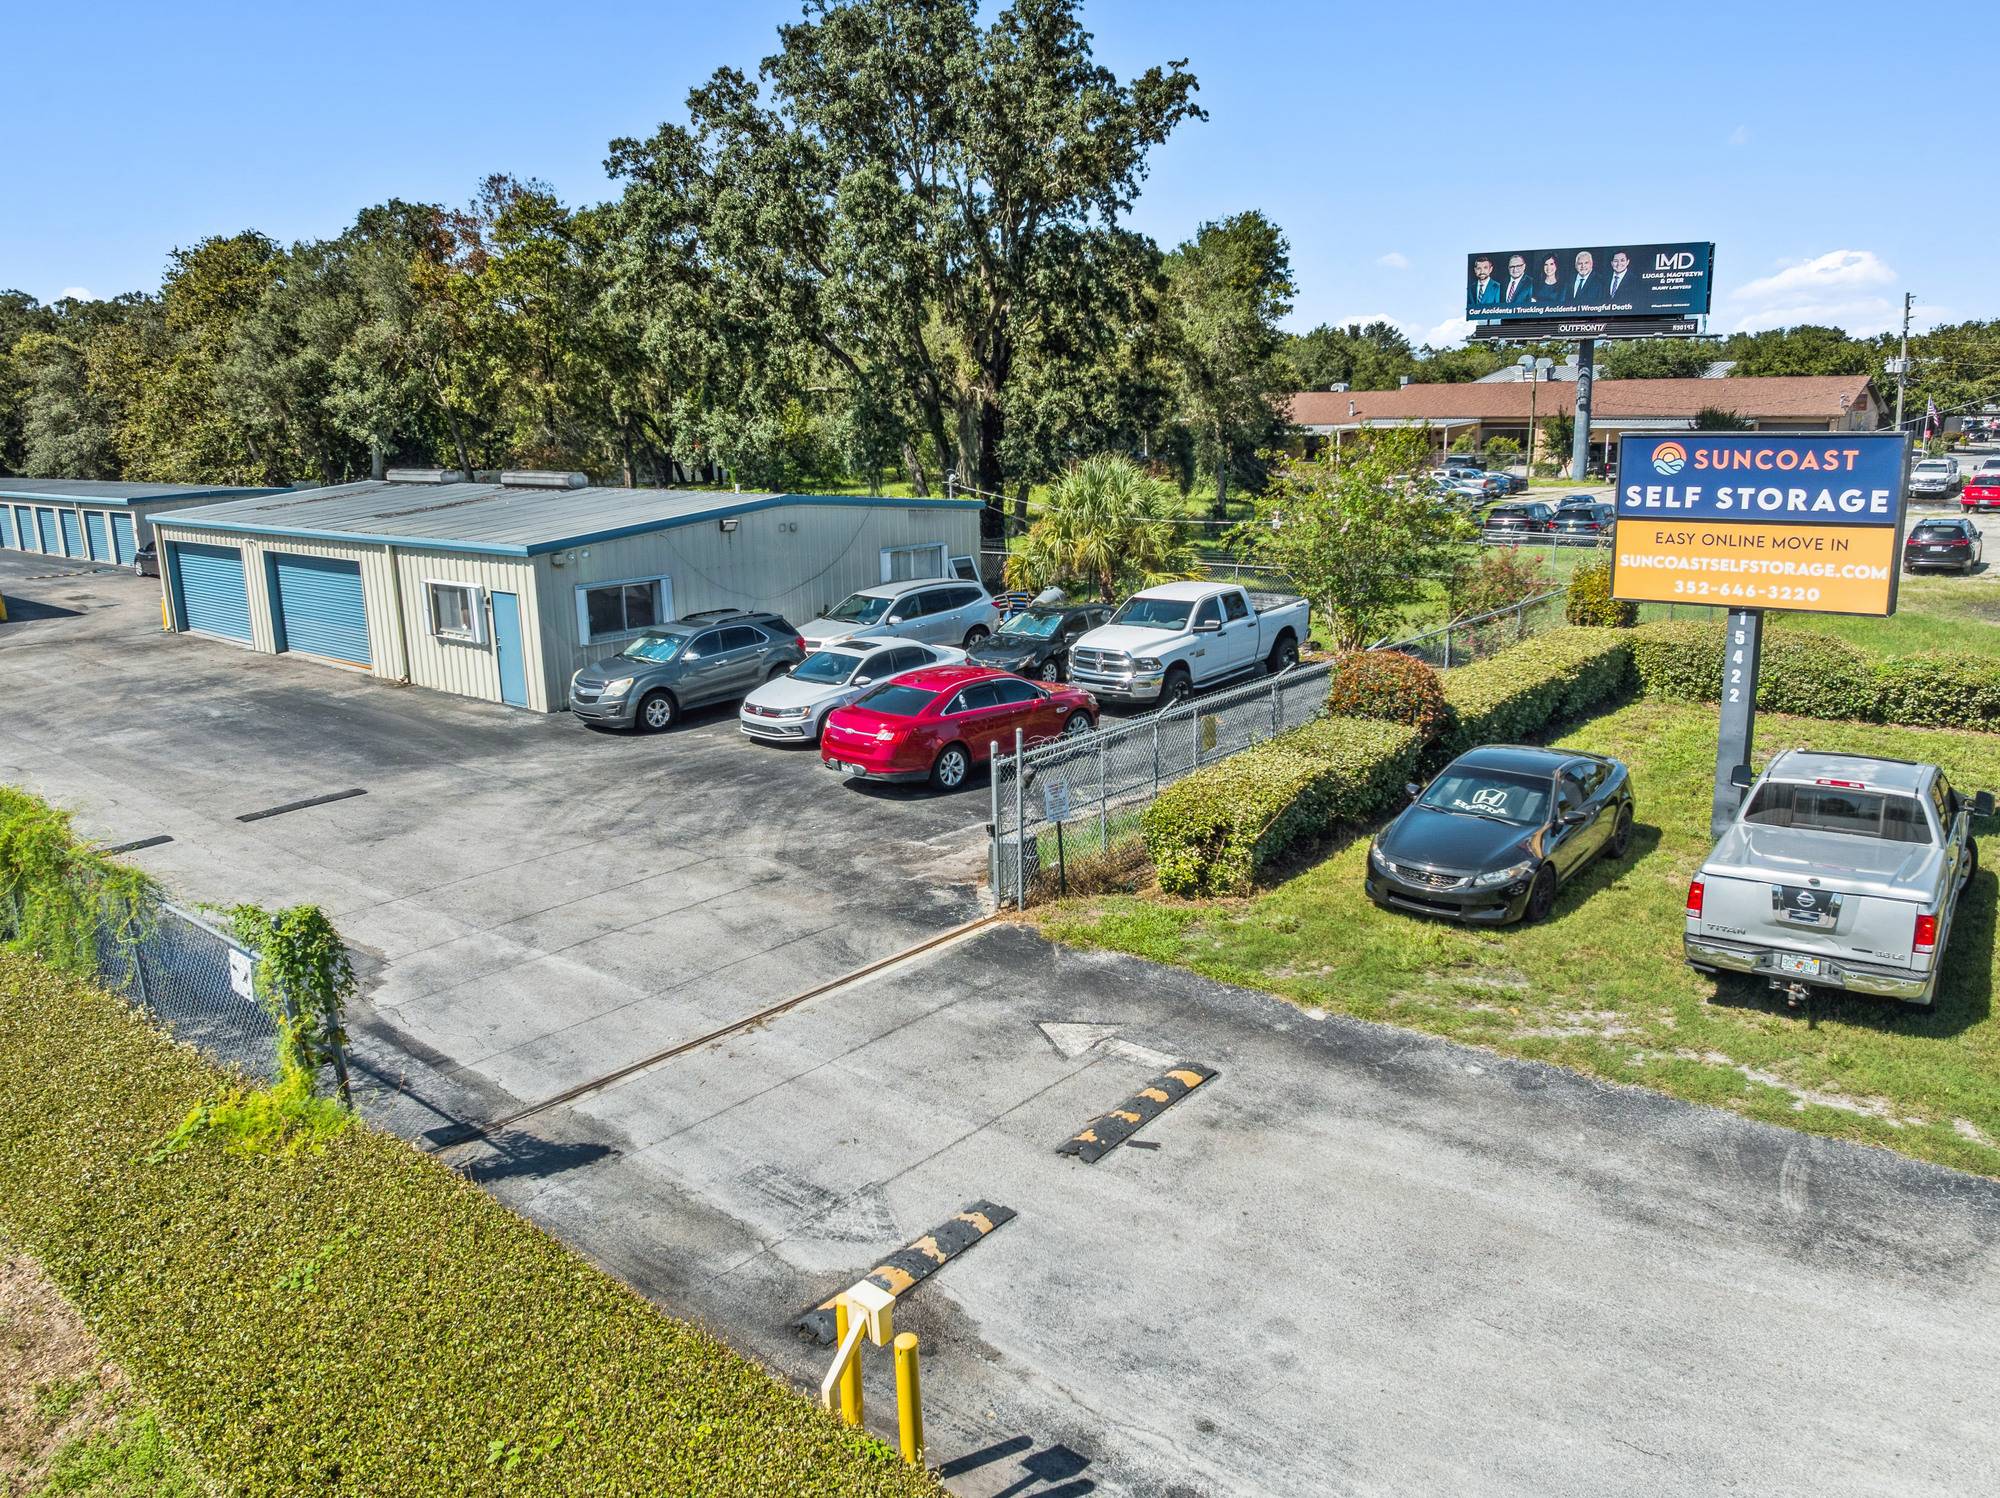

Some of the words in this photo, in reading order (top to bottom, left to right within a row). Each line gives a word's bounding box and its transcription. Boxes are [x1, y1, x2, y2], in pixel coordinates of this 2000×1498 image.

[1655, 252, 1695, 271] LMD
[1481, 306, 1513, 315] Accidents
[1516, 306, 1544, 315] Trucking
[1545, 305, 1577, 313] Accidents
[1581, 303, 1611, 313] Wrongful
[1694, 450, 1860, 471] SUNCOAST
[1625, 485, 1703, 509] SELF
[1715, 487, 1890, 513] STORAGE
[1655, 531, 1696, 545] EASY
[1702, 533, 1766, 548] ONLINE
[1772, 536, 1824, 551] MOVE
[1831, 538, 1849, 551] IN
[1619, 554, 1888, 580] SUNCOASTSELFSTORAGE.COM
[1674, 580, 1821, 602] 352-646-3220
[1706, 923, 1746, 935] TITAN
